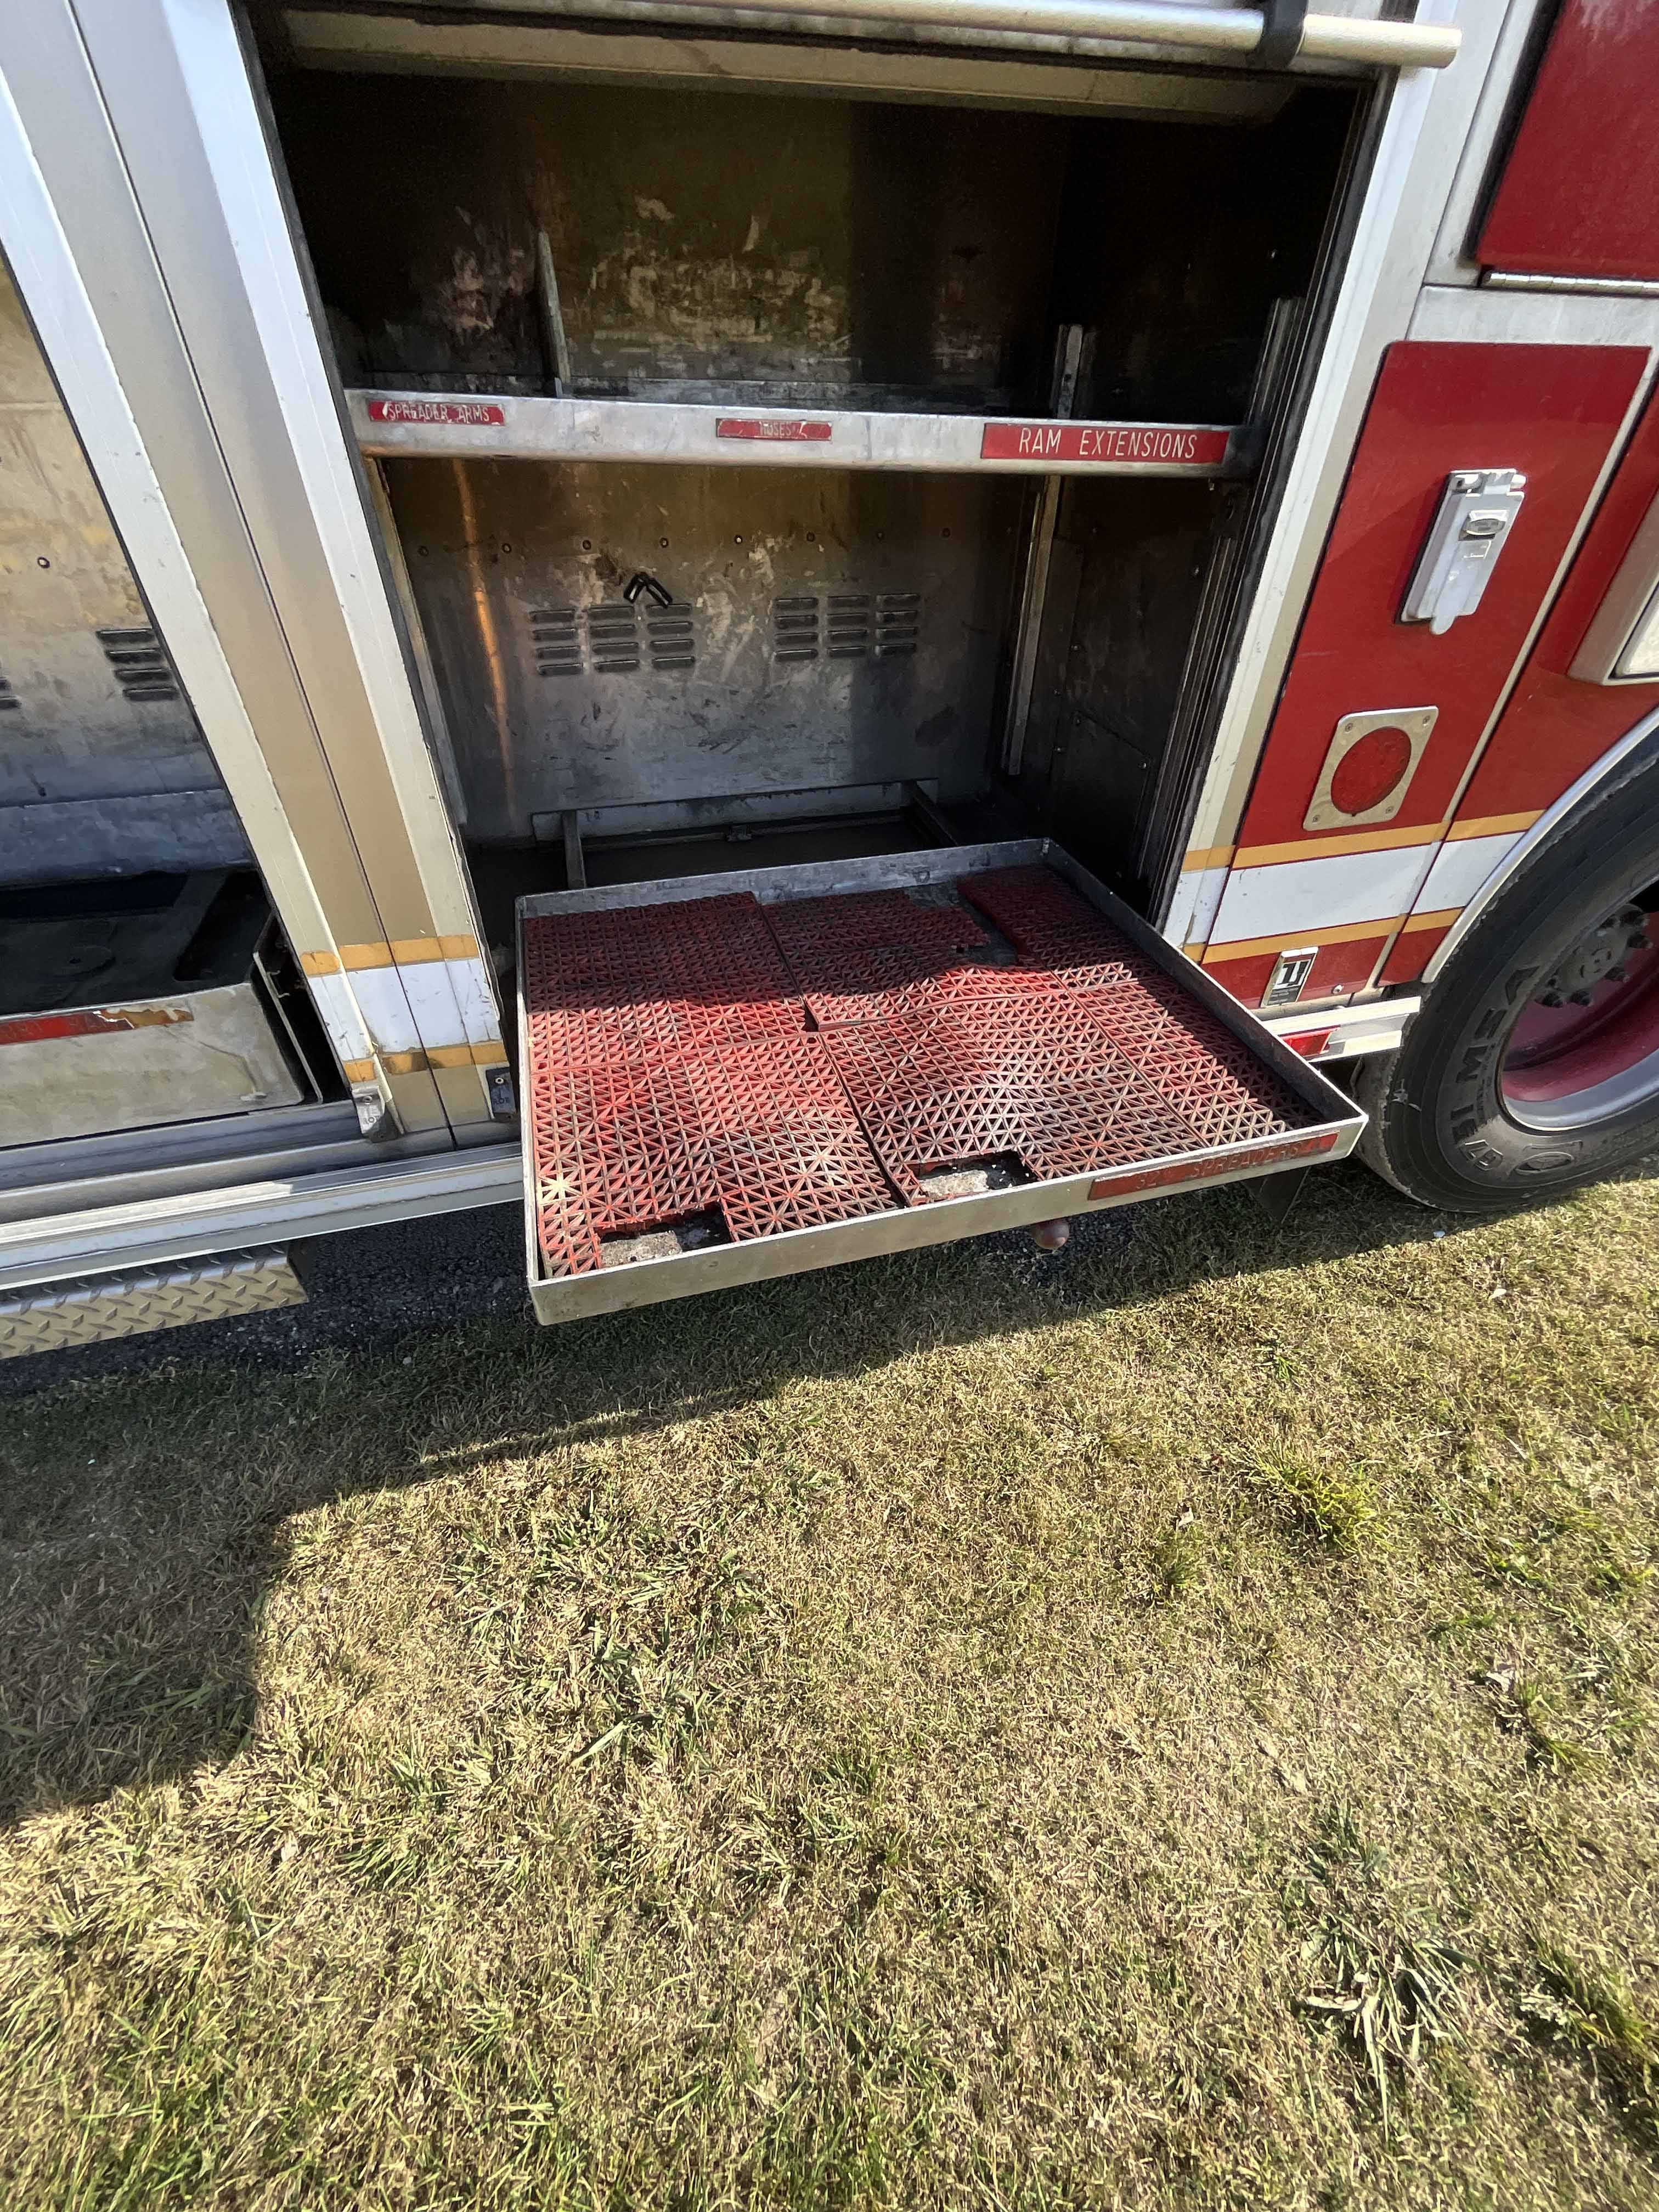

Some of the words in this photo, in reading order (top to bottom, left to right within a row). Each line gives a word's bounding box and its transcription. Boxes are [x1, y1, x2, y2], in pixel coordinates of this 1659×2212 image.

[390, 403, 448, 421] SPREADER
[457, 405, 490, 422] ARMS
[1019, 427, 1062, 453] RAM
[1079, 430, 1197, 459] EXTENSIONS
[1190, 1142, 1301, 1177] SPREADERS
